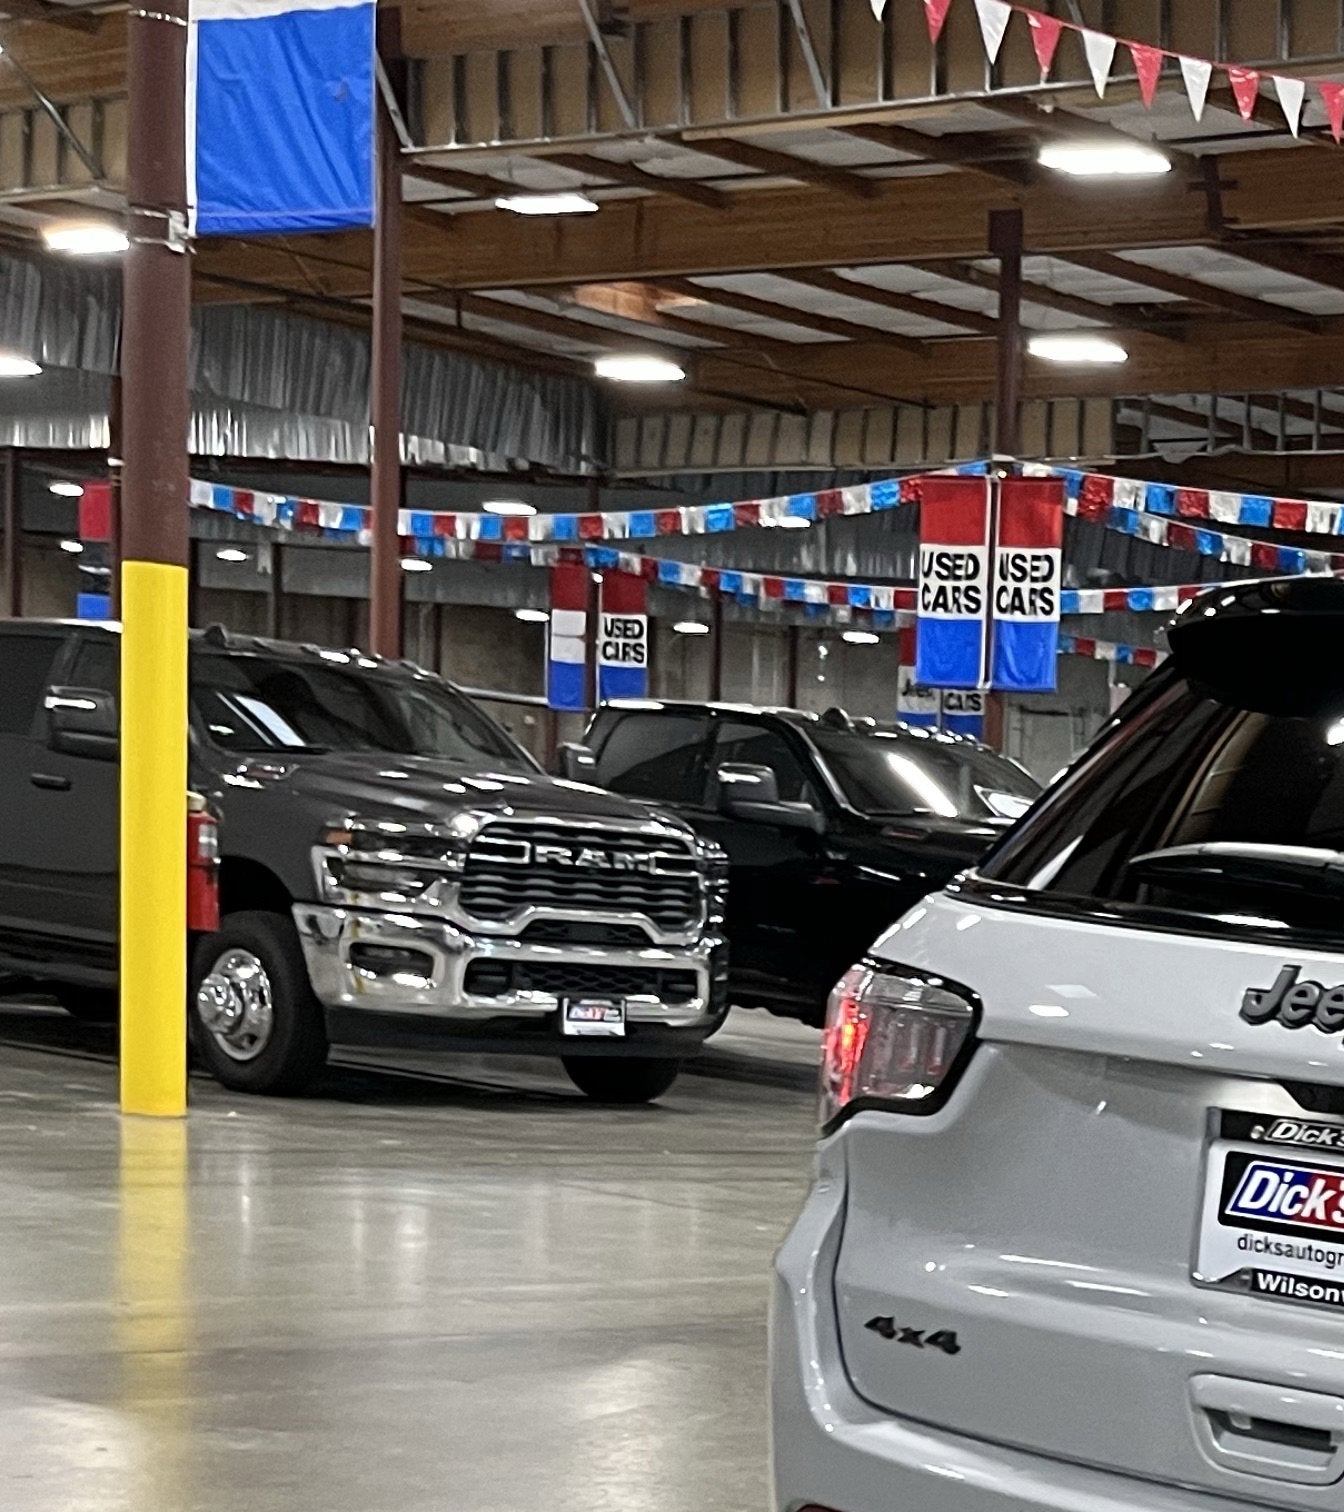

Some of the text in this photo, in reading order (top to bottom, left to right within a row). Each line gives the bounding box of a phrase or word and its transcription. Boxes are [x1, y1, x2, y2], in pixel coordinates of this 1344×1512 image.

[921, 551, 980, 581] USED
[999, 553, 1055, 583] USED
[921, 583, 981, 614] CARS
[996, 586, 1054, 616] CARS
[604, 616, 645, 639] USED
[944, 692, 982, 712] CS
[535, 845, 652, 872] RAM
[864, 1316, 961, 1355] 4x4
